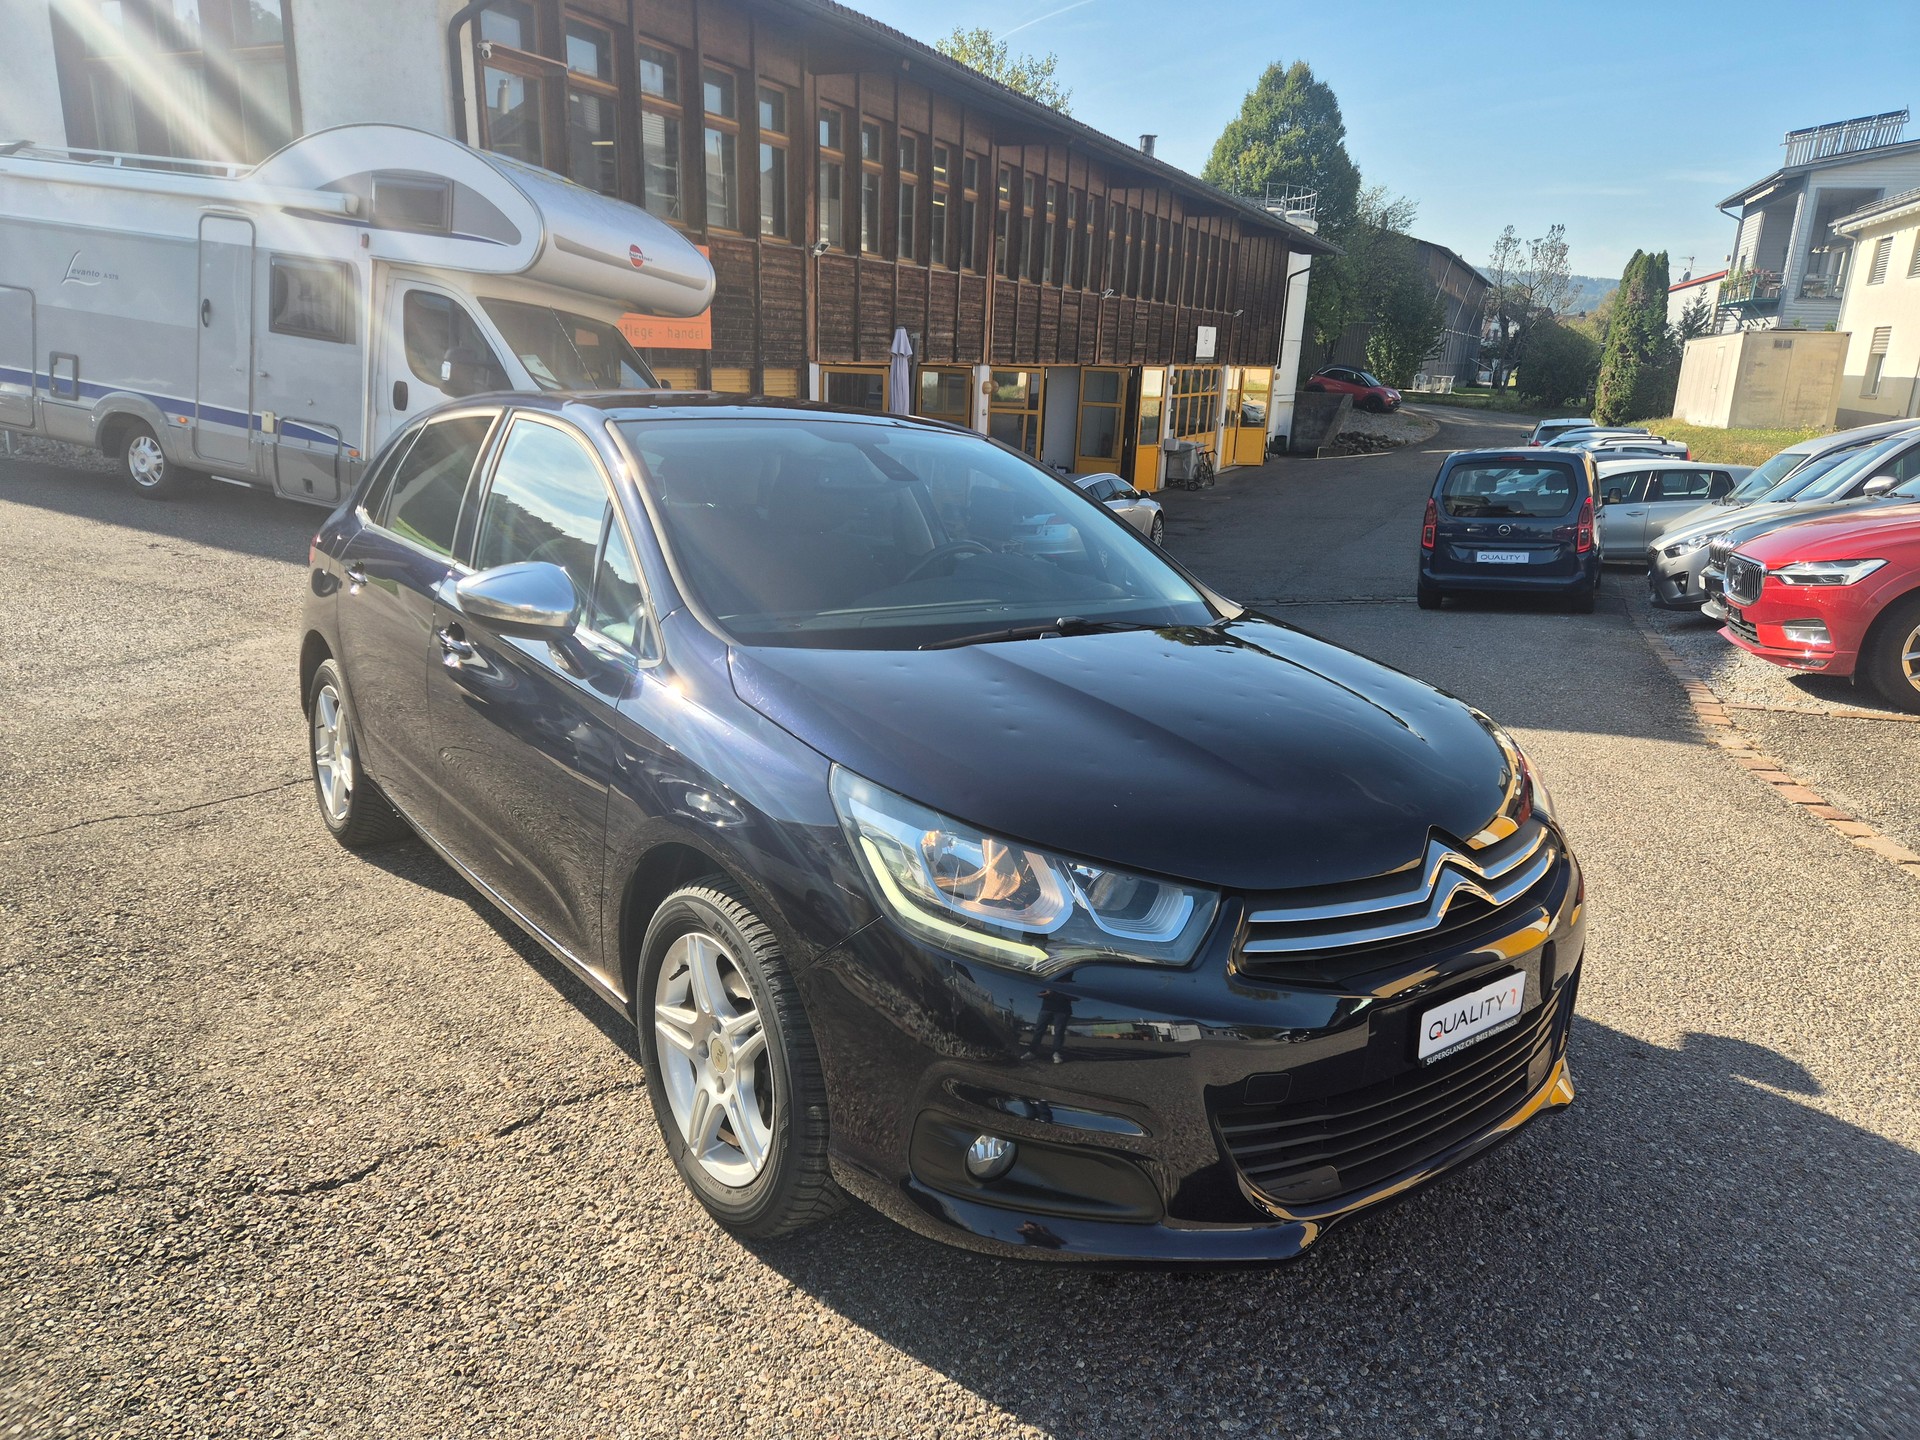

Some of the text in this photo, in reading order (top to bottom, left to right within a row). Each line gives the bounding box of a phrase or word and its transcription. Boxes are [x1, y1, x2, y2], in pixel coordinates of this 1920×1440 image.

[61, 250, 101, 285] Levanto
[667, 327, 703, 339] handel
[1480, 553, 1520, 561] QUALITY
[1429, 988, 1516, 1040] QUALITY 1
